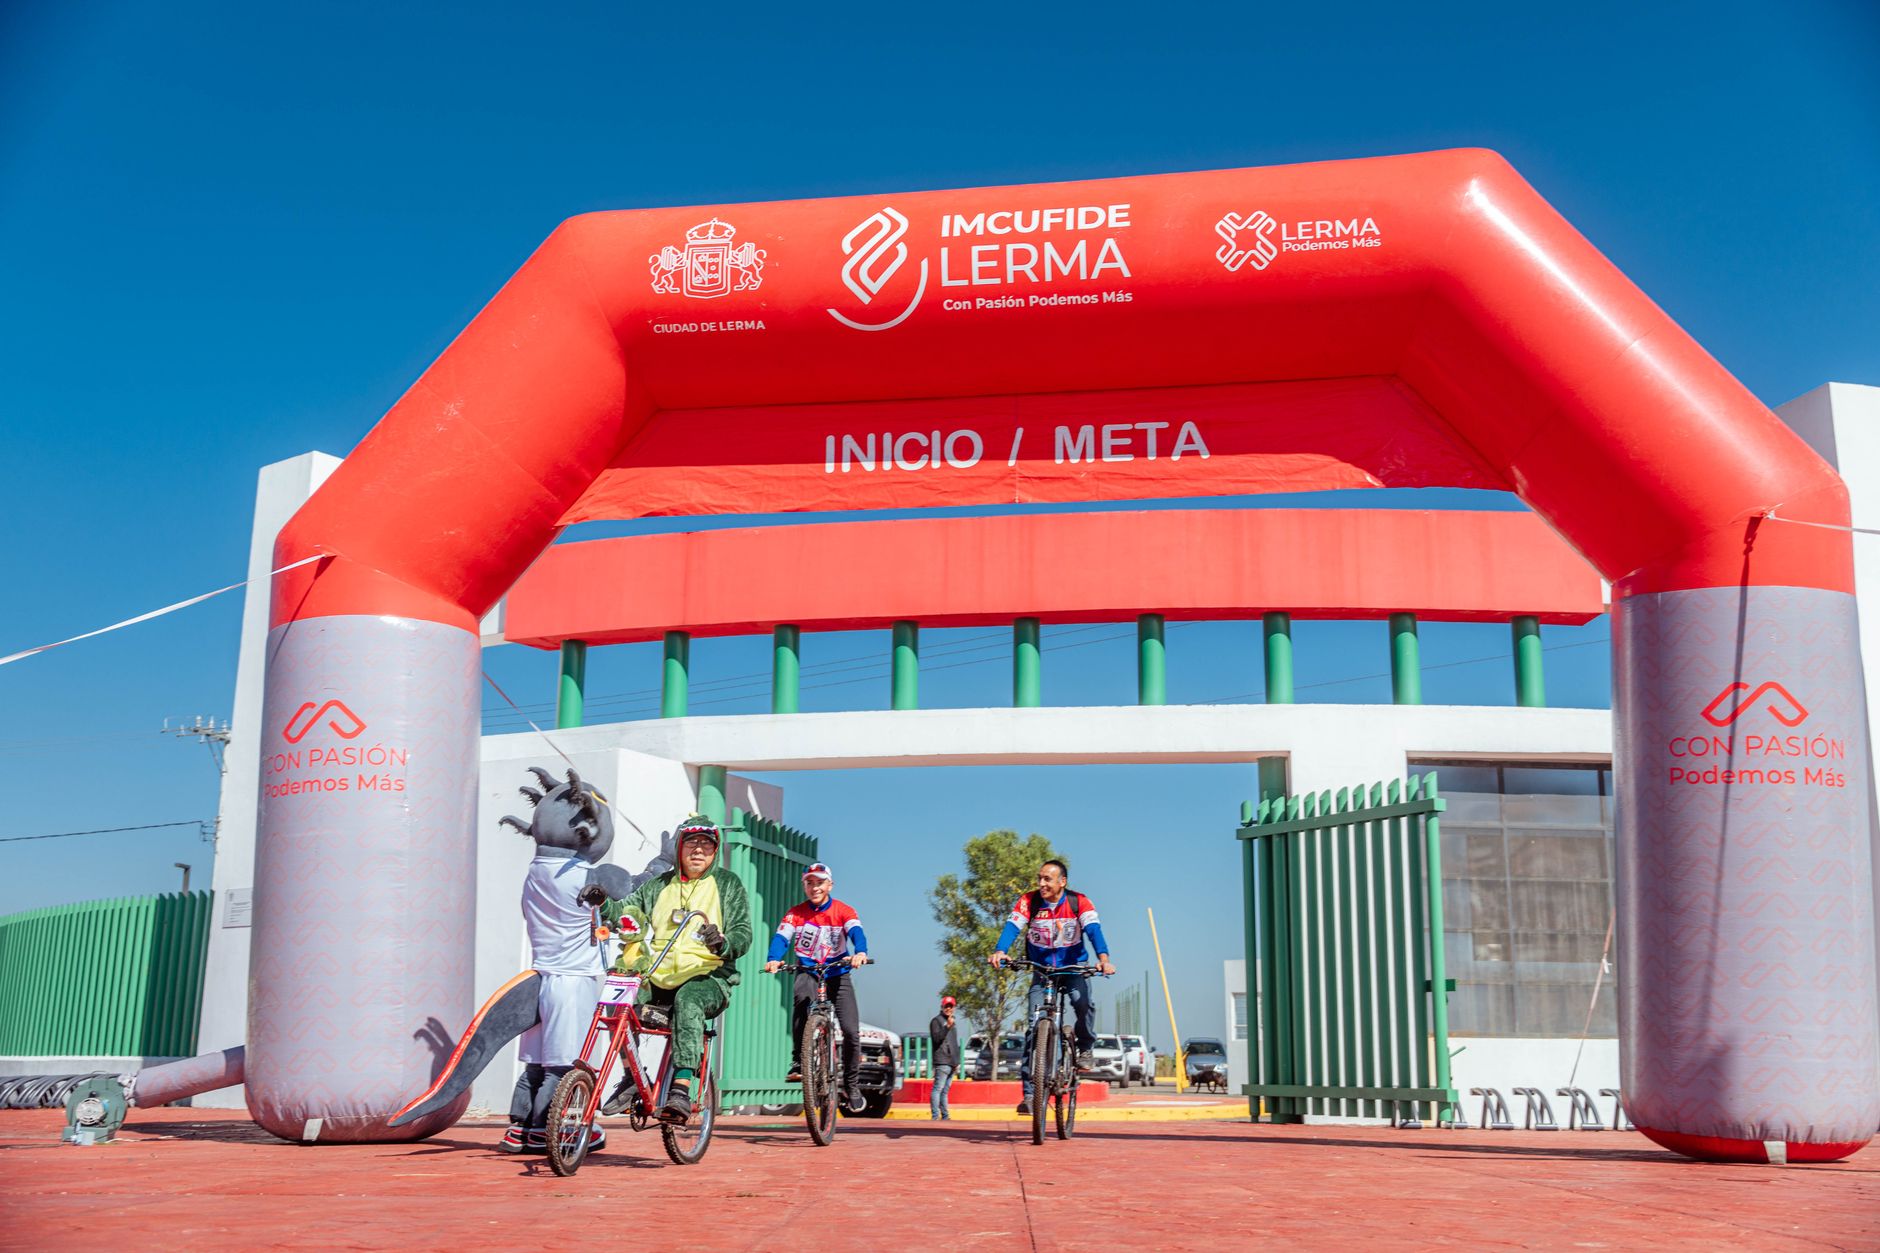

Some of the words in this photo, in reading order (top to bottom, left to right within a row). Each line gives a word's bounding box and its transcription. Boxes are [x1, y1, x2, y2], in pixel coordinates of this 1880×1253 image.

[941, 203, 1131, 238] IMCUFIDE
[1281, 217, 1381, 241] LERMA
[1282, 240, 1350, 253] Podemos
[1352, 236, 1382, 249] Más
[940, 238, 1132, 287] LERMA
[943, 299, 972, 311] Con
[976, 295, 1026, 310] Pasión
[1029, 291, 1099, 307] Podemos
[1103, 290, 1133, 304] Más
[653, 322, 699, 334] CIUDAD
[701, 321, 718, 332] DE
[719, 320, 766, 331] LERMA
[825, 429, 984, 473] INICIO
[1054, 421, 1211, 464] META
[308, 743, 407, 768] PASIÓN
[1668, 735, 1733, 758] CON
[1745, 732, 1845, 760] PASIÓN
[264, 776, 350, 800] Podemos
[357, 773, 406, 792] Más
[1669, 765, 1796, 786] Podemos
[1804, 767, 1846, 788] Más
[612, 988, 625, 1001] 7
